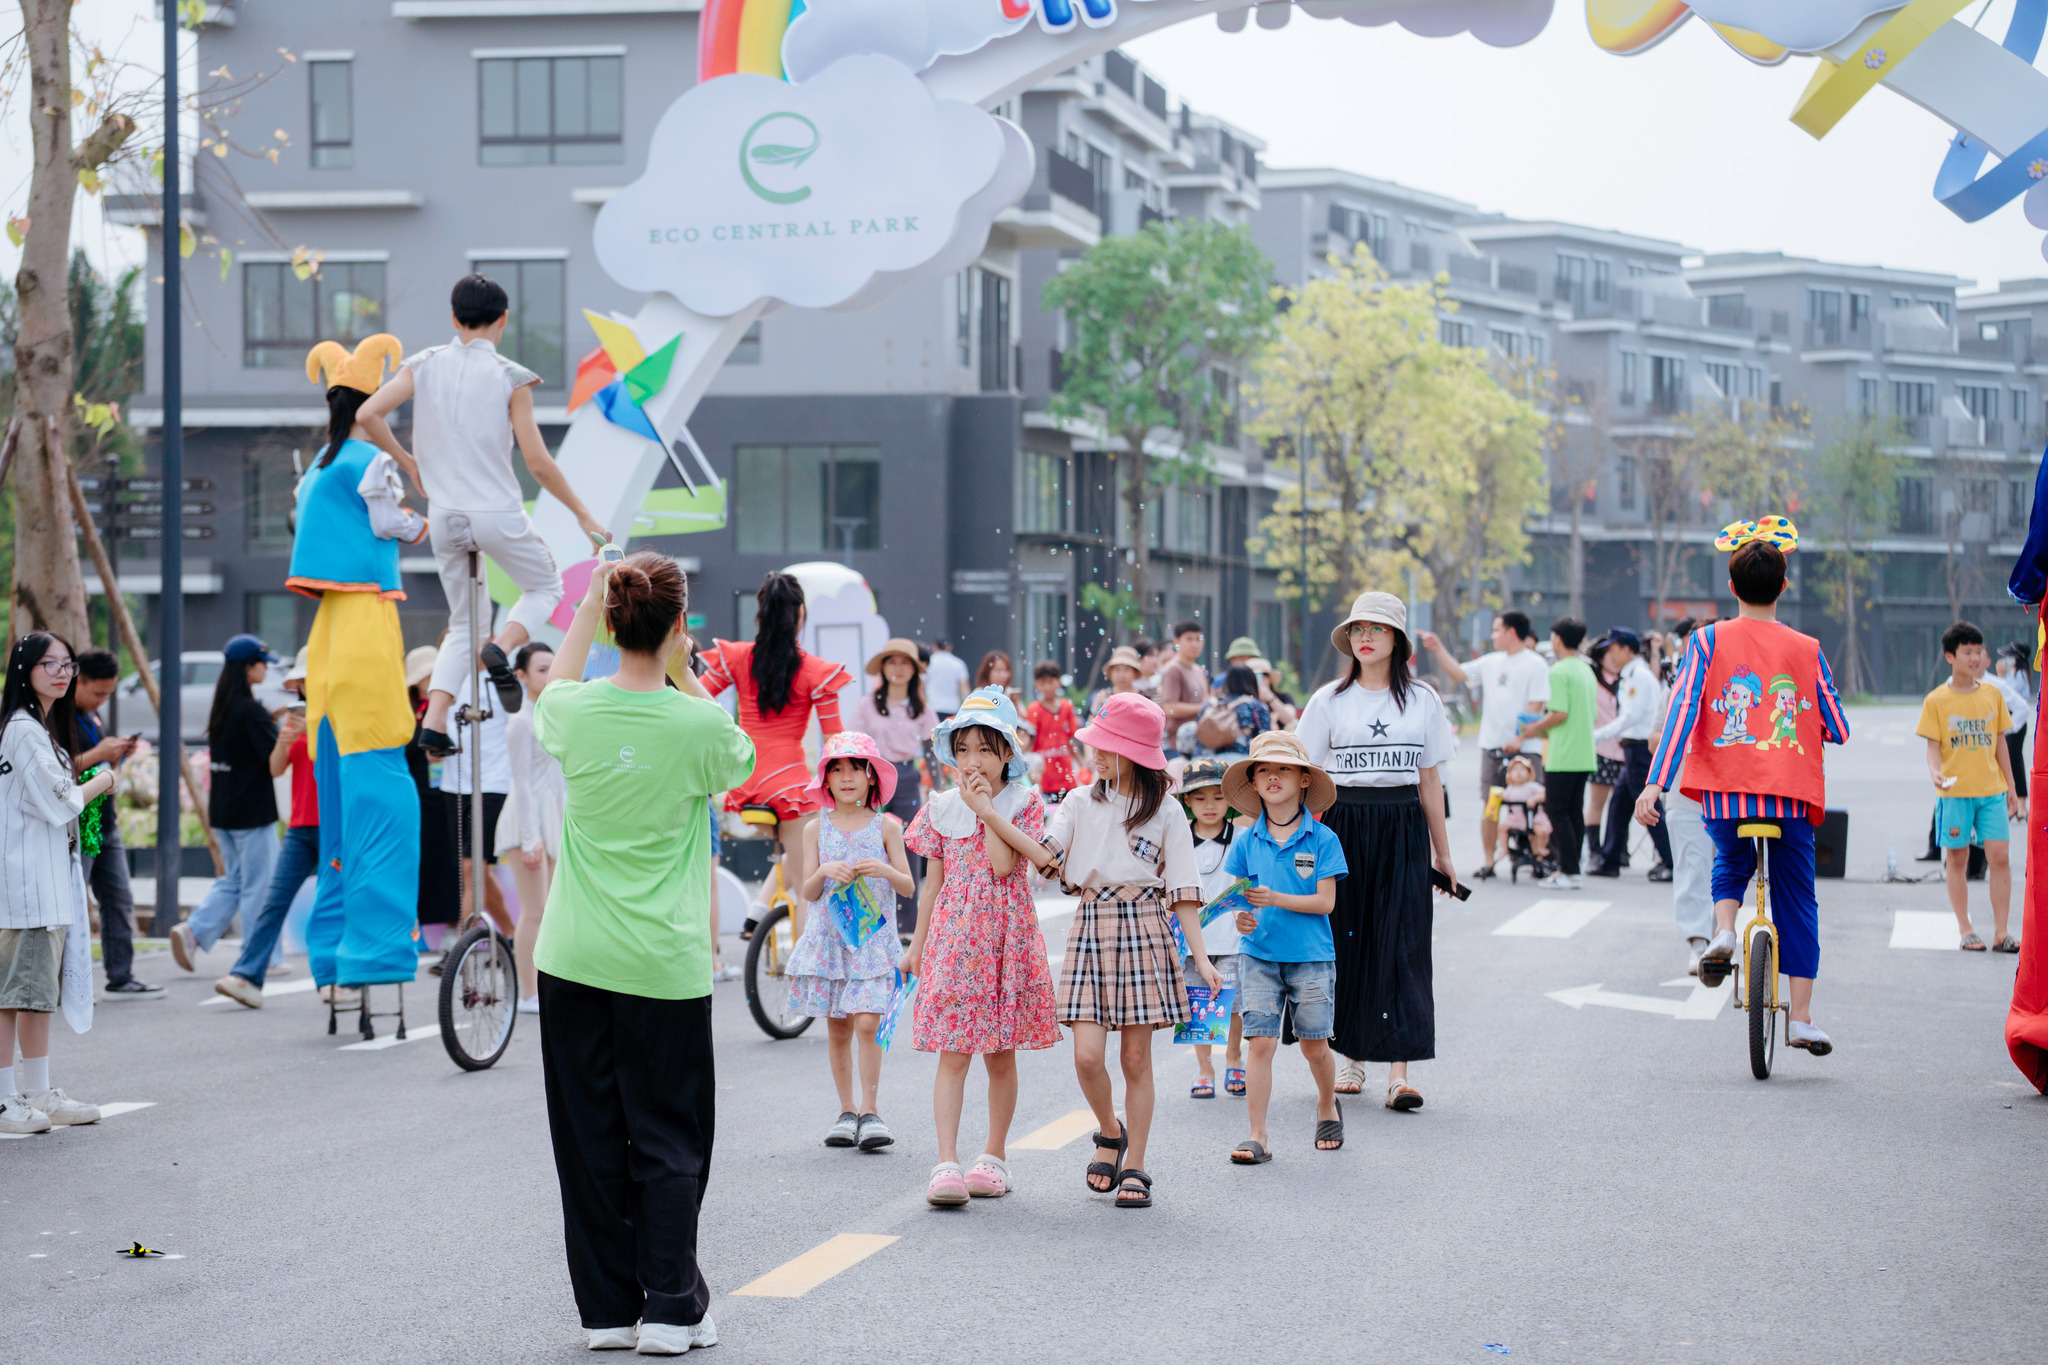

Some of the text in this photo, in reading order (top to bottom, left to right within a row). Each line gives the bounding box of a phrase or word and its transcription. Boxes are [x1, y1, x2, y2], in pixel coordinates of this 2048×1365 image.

[648, 216, 920, 245] ECO CENTRAL PARK
